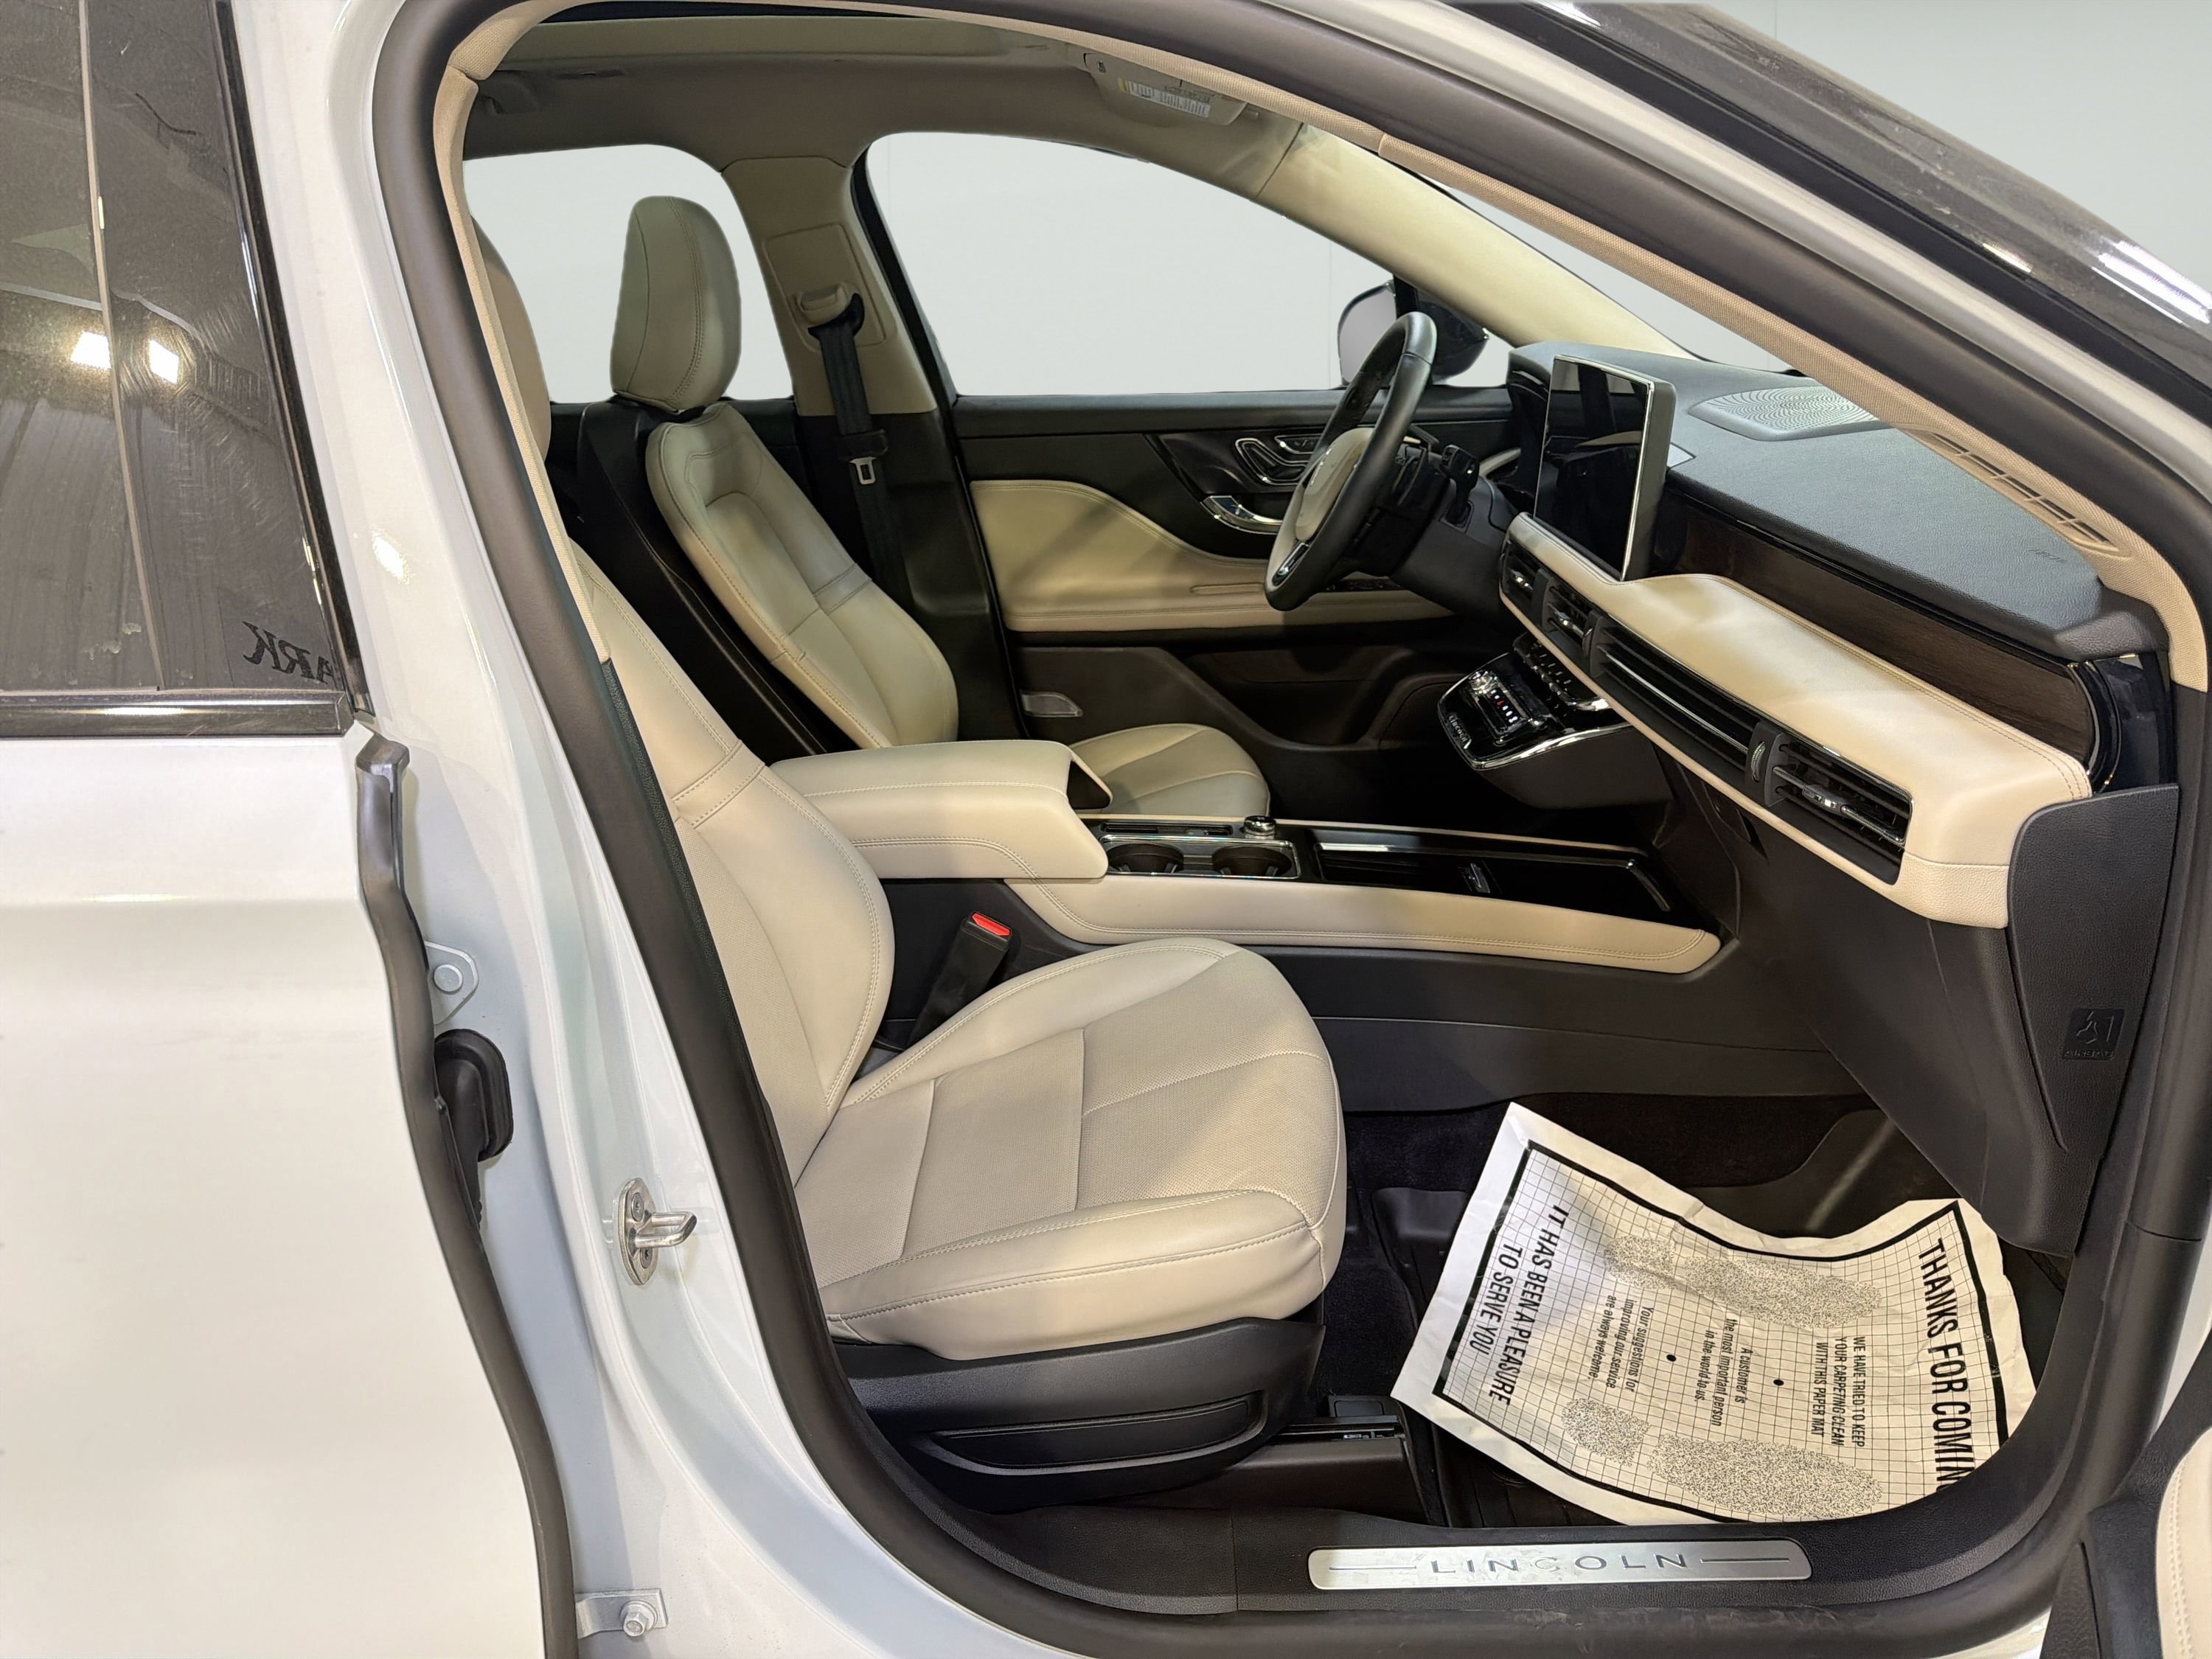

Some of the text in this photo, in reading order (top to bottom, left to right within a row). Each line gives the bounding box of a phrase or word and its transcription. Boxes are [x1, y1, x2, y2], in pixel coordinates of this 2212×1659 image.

[1469, 1243, 1523, 1355] TO SERVE YOU
[1488, 1205, 1570, 1406] IT HAS BEEN A PLEASURE
[1919, 1237, 1958, 1339] THANKS
[1587, 1295, 1617, 1380] are always welcome.
[1605, 1298, 1637, 1389] improving our service
[1624, 1306, 1654, 1392] Your suggestions for
[1698, 1355, 1711, 1379] world
[1702, 1340, 1716, 1354] the
[1704, 1329, 1718, 1339] in
[1711, 1318, 1738, 1427] the most important person
[1734, 1346, 1753, 1404] A customer is
[1928, 1342, 1969, 1394] FOR
[1697, 1380, 1709, 1388] to
[1811, 1342, 1829, 1438] WITH THIS PAPER MAT
[1831, 1336, 1847, 1446] YOUR CARPETING CLEAN
[1851, 1336, 1866, 1447] WE HAVE TRIED TO KEEP
[1430, 1553, 1688, 1574] LINCOLN
